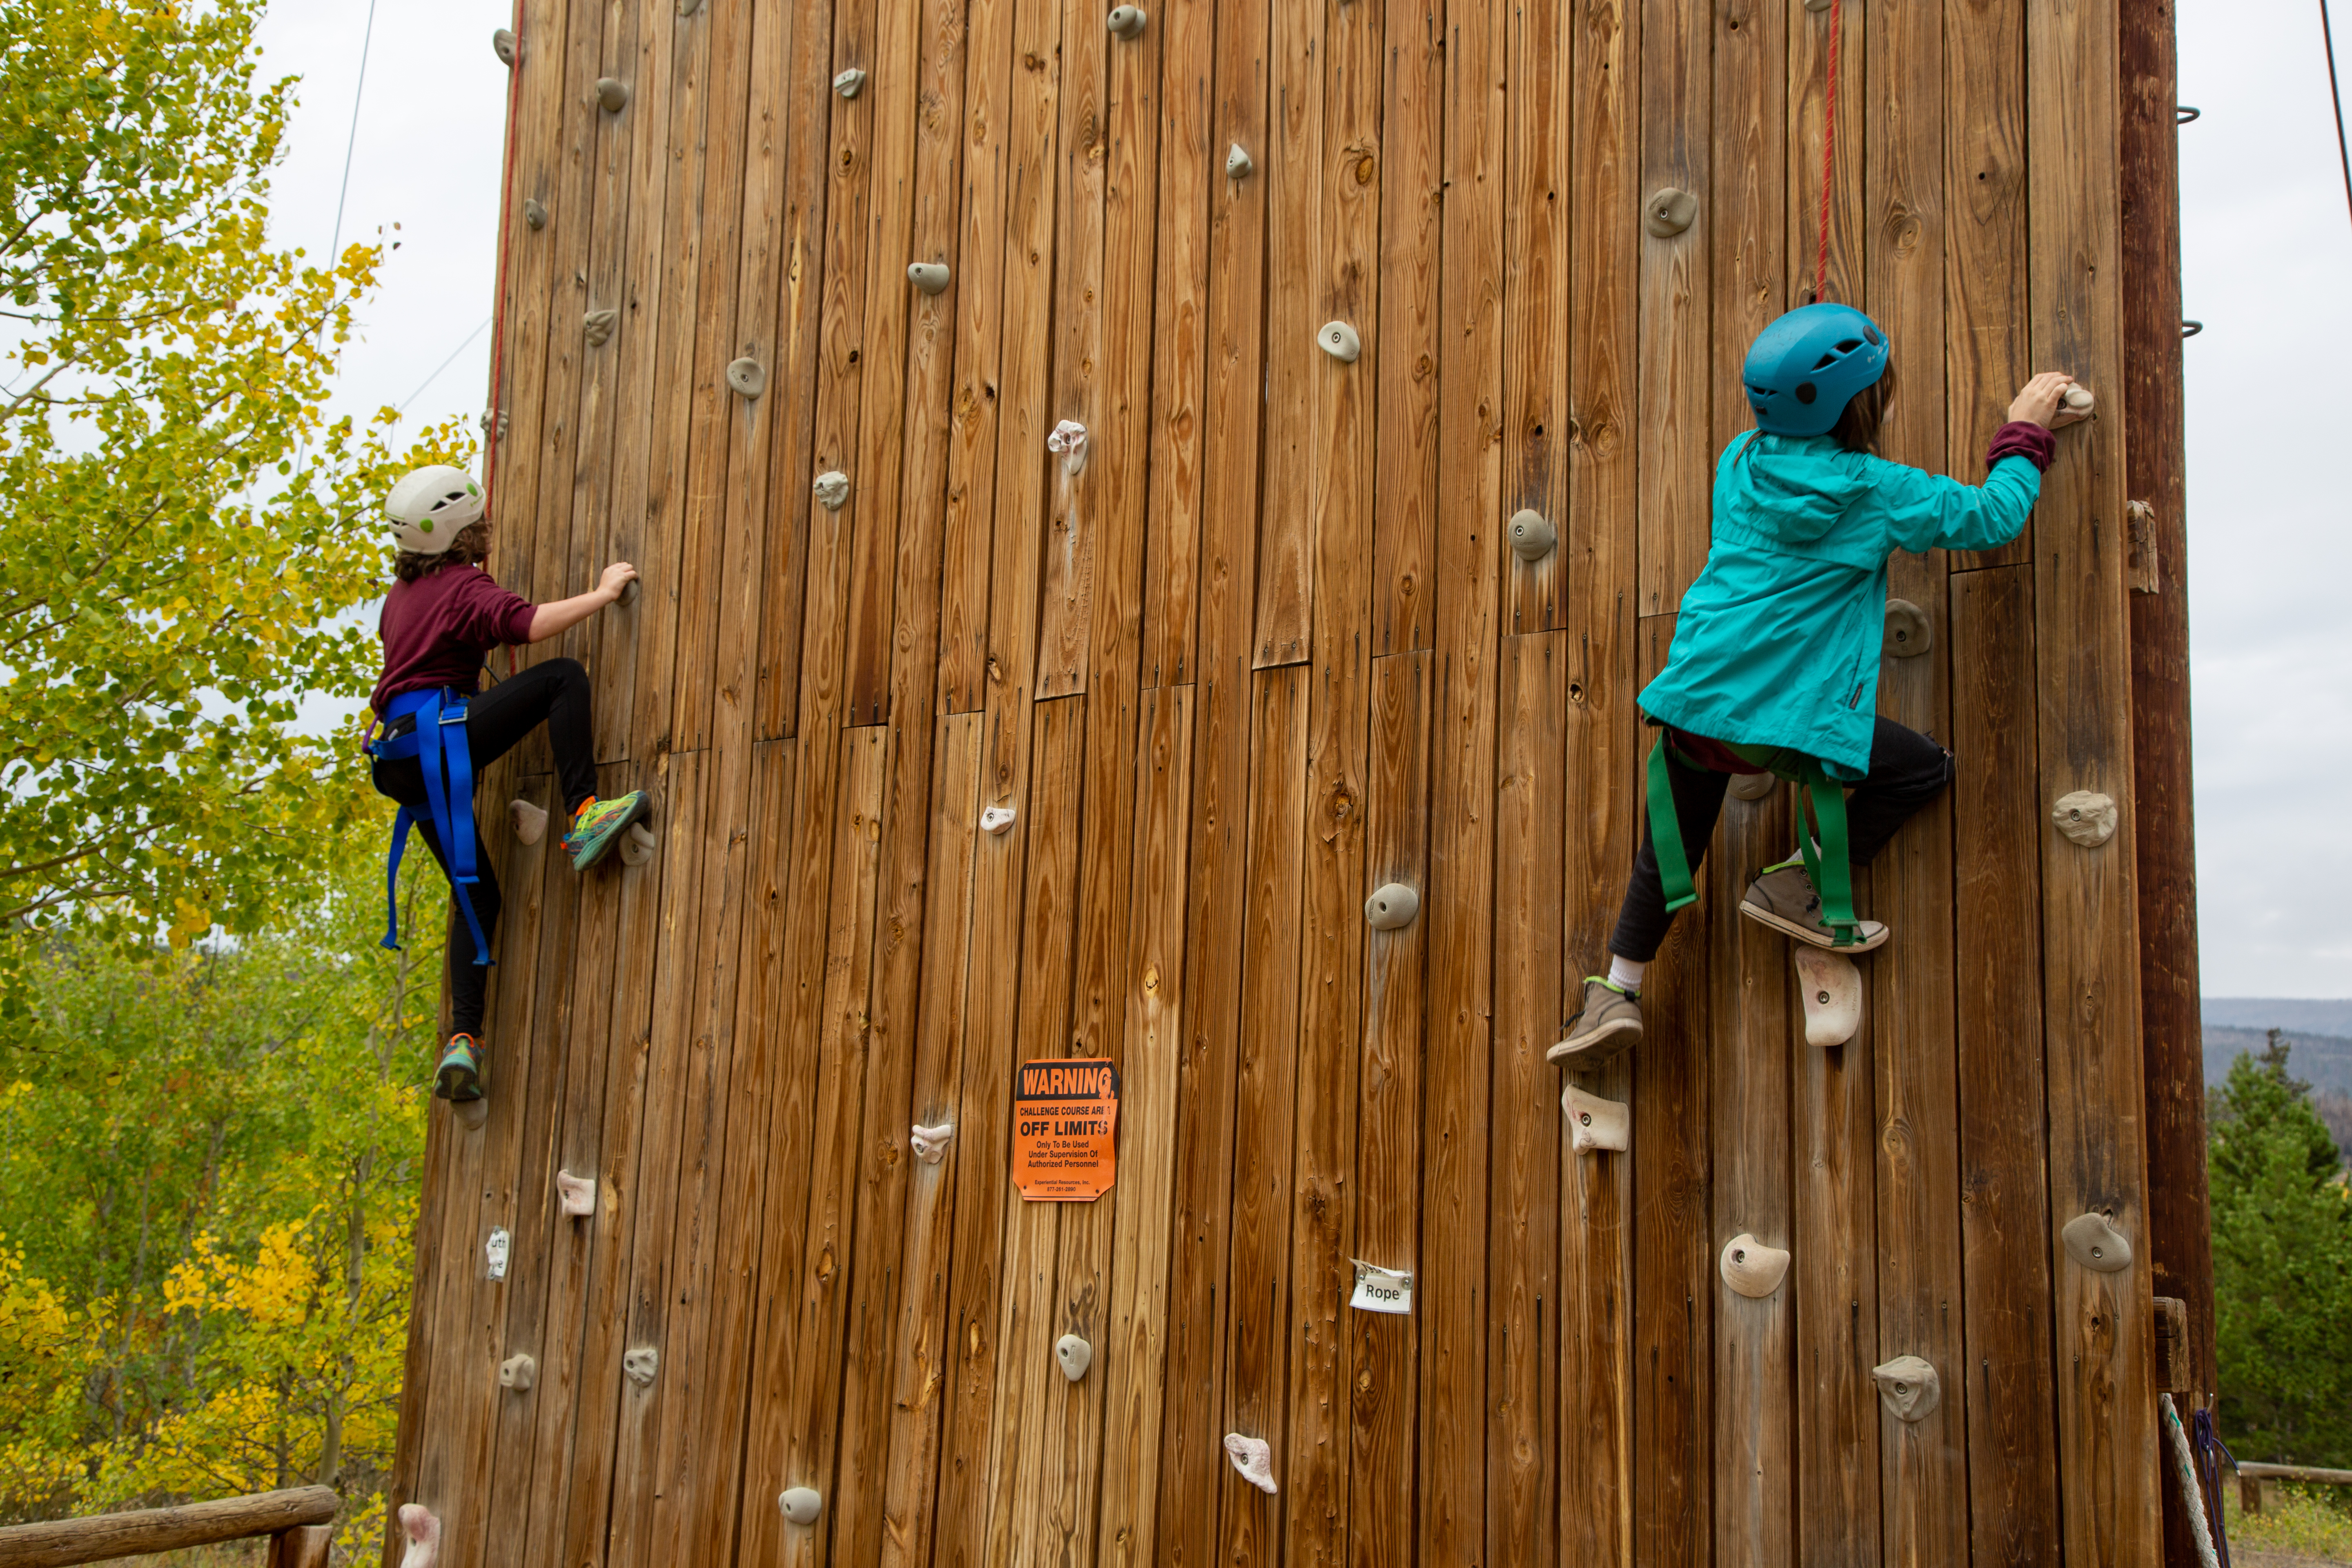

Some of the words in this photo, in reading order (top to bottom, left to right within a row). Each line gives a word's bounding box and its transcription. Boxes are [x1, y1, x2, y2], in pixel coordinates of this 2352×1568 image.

[1024, 1067, 1112, 1095] WARNING
[1020, 1107, 1059, 1116] CHALLENGE
[1061, 1107, 1089, 1116] COURSE
[1020, 1122, 1049, 1136] OFF
[1055, 1120, 1108, 1136] LIMITS
[1036, 1141, 1051, 1149] Only
[1049, 1150, 1087, 1160] Supervision
[1366, 1284, 1399, 1302] Rope
